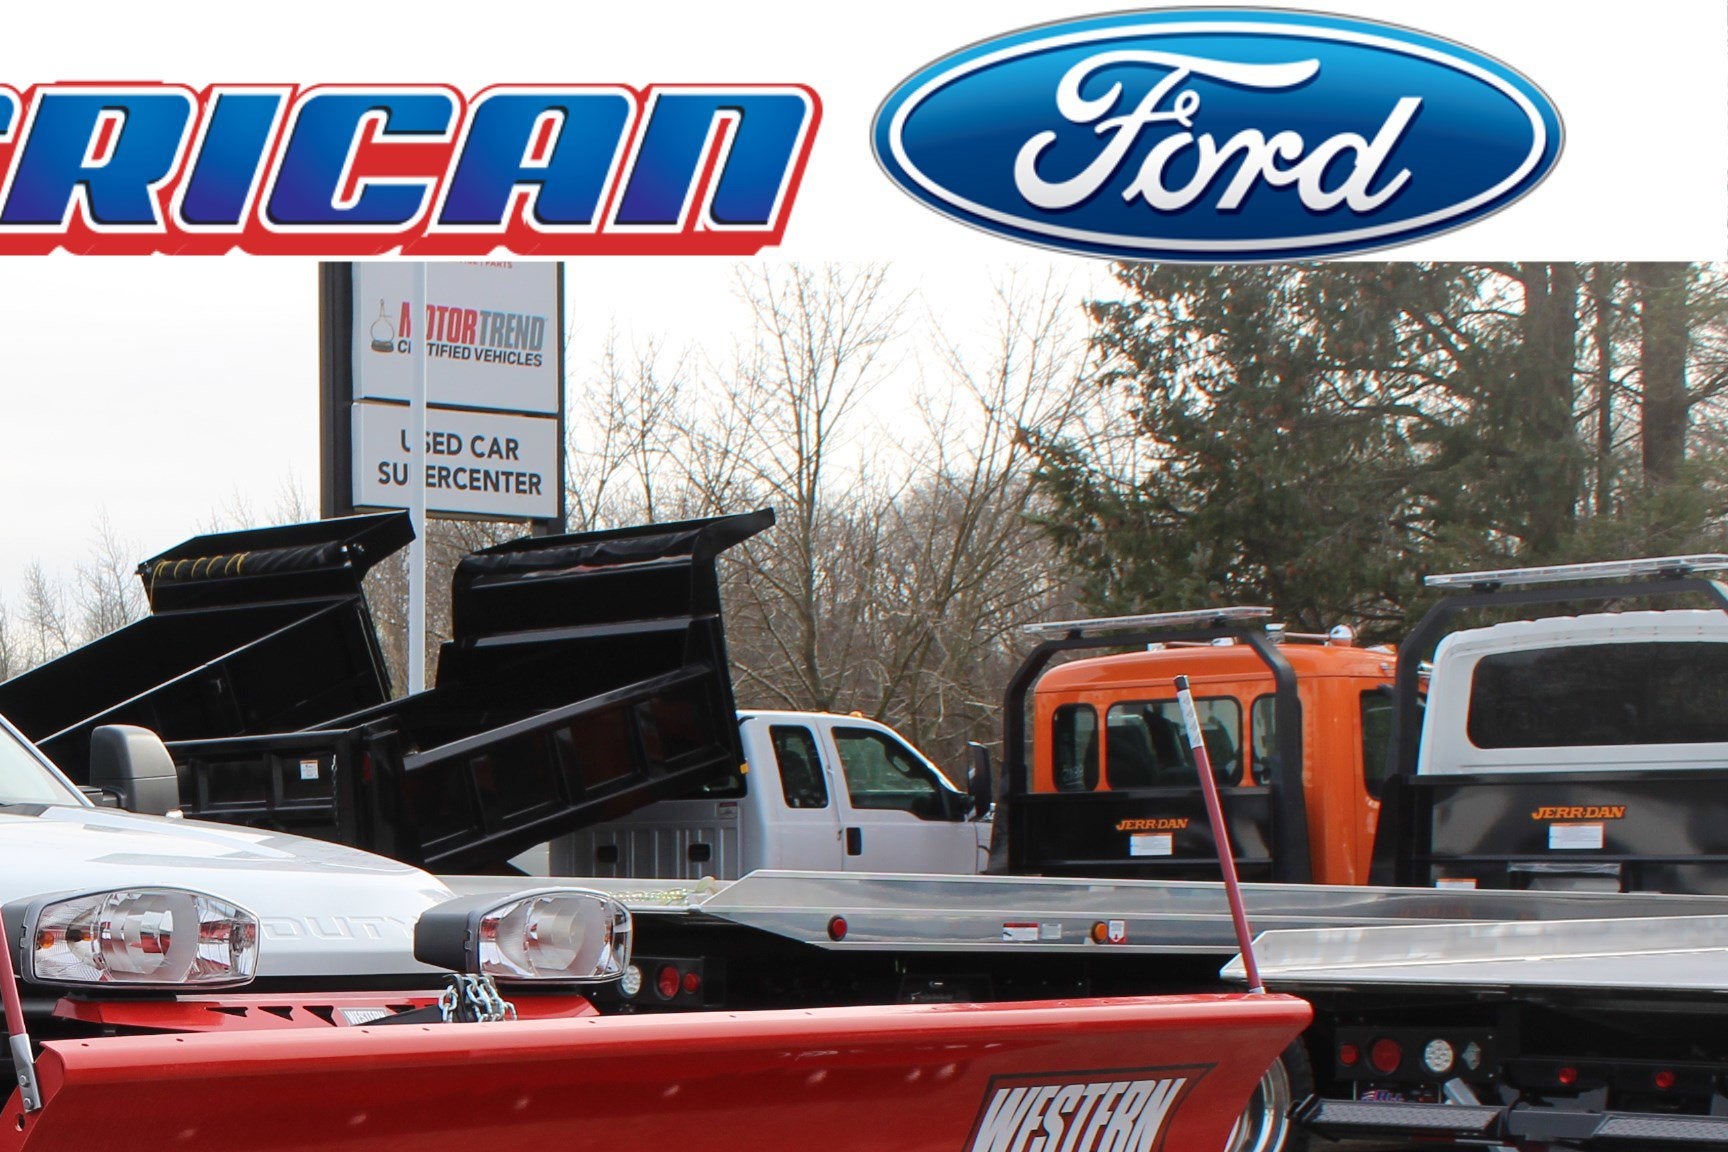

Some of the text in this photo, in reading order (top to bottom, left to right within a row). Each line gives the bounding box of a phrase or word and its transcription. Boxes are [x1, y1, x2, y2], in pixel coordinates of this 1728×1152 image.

[397, 340, 543, 367] CTIFIED VEHICLES
[470, 435, 520, 460] CAR
[378, 461, 542, 496] SUERCENTER
